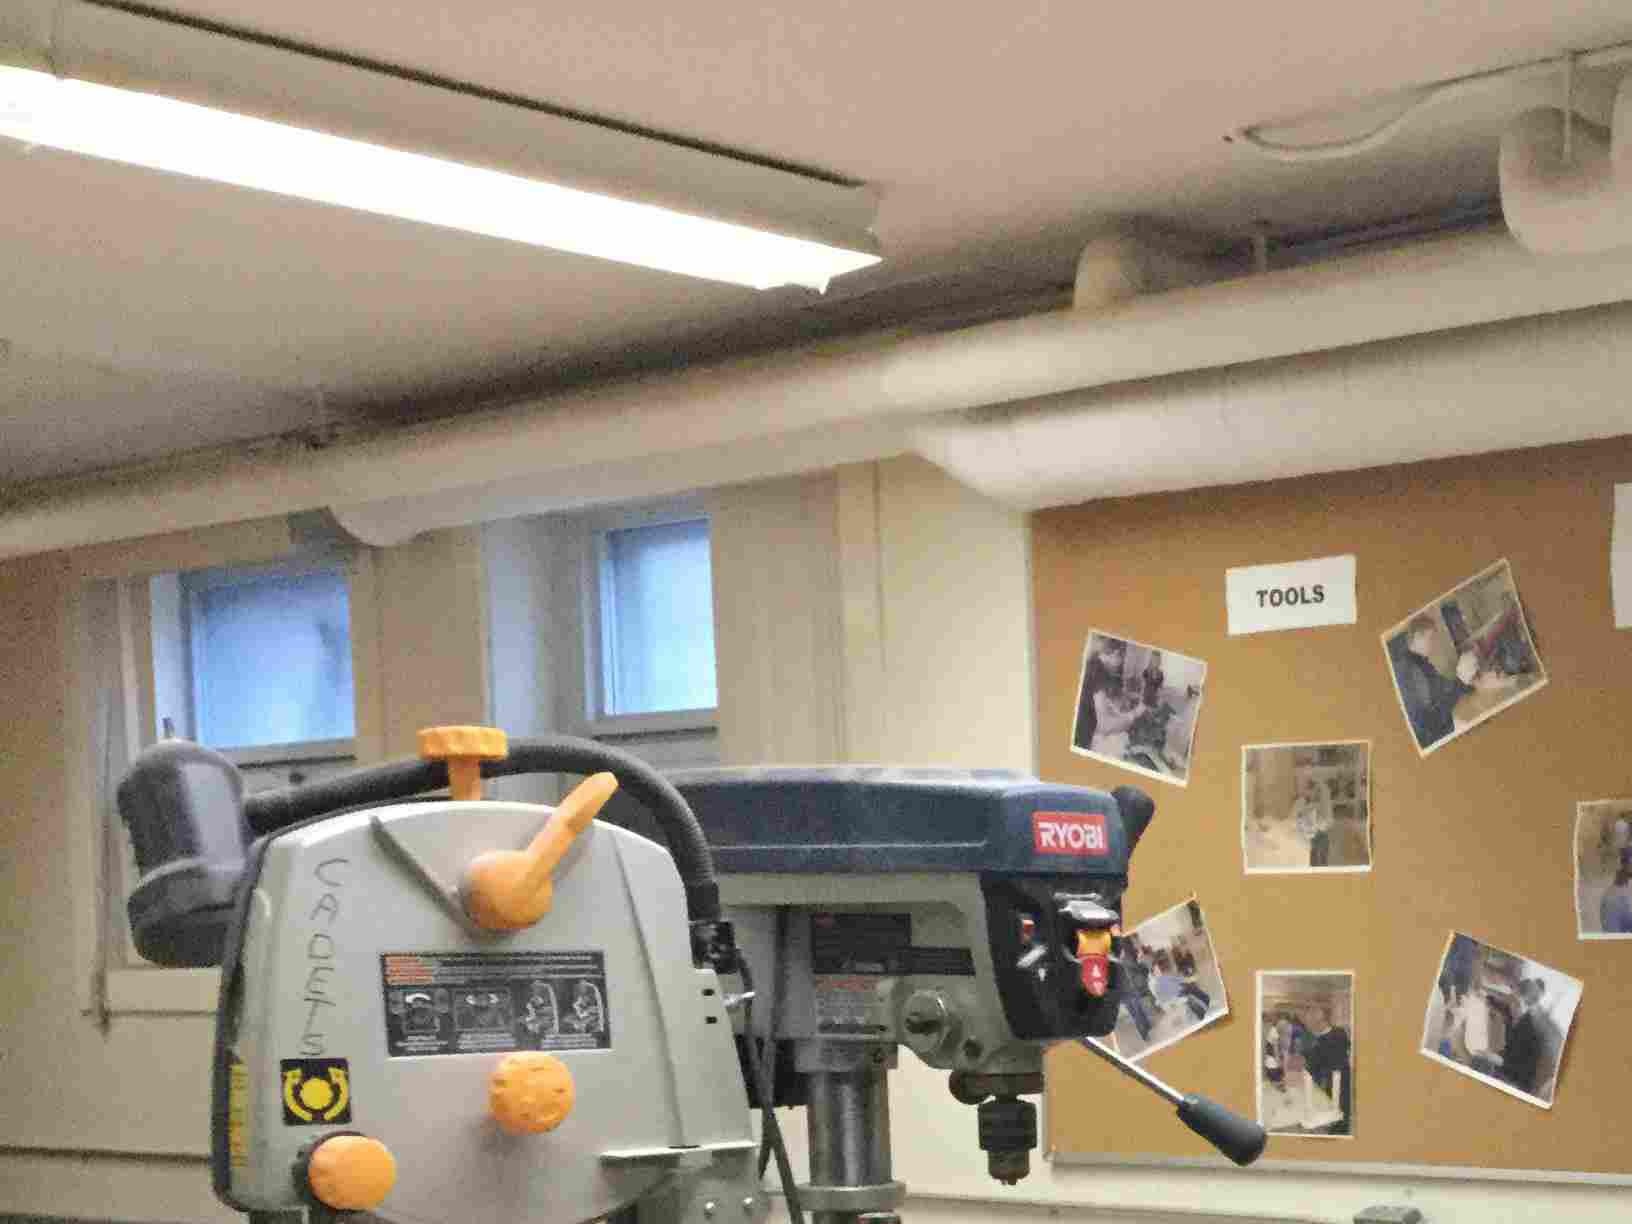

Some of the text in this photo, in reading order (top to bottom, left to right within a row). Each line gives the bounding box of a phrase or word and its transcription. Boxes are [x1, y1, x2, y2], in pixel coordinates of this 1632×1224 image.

[1256, 584, 1325, 608] TOOLS
[1038, 821, 1104, 850] RYOBI
[299, 857, 351, 1057] CADETS
